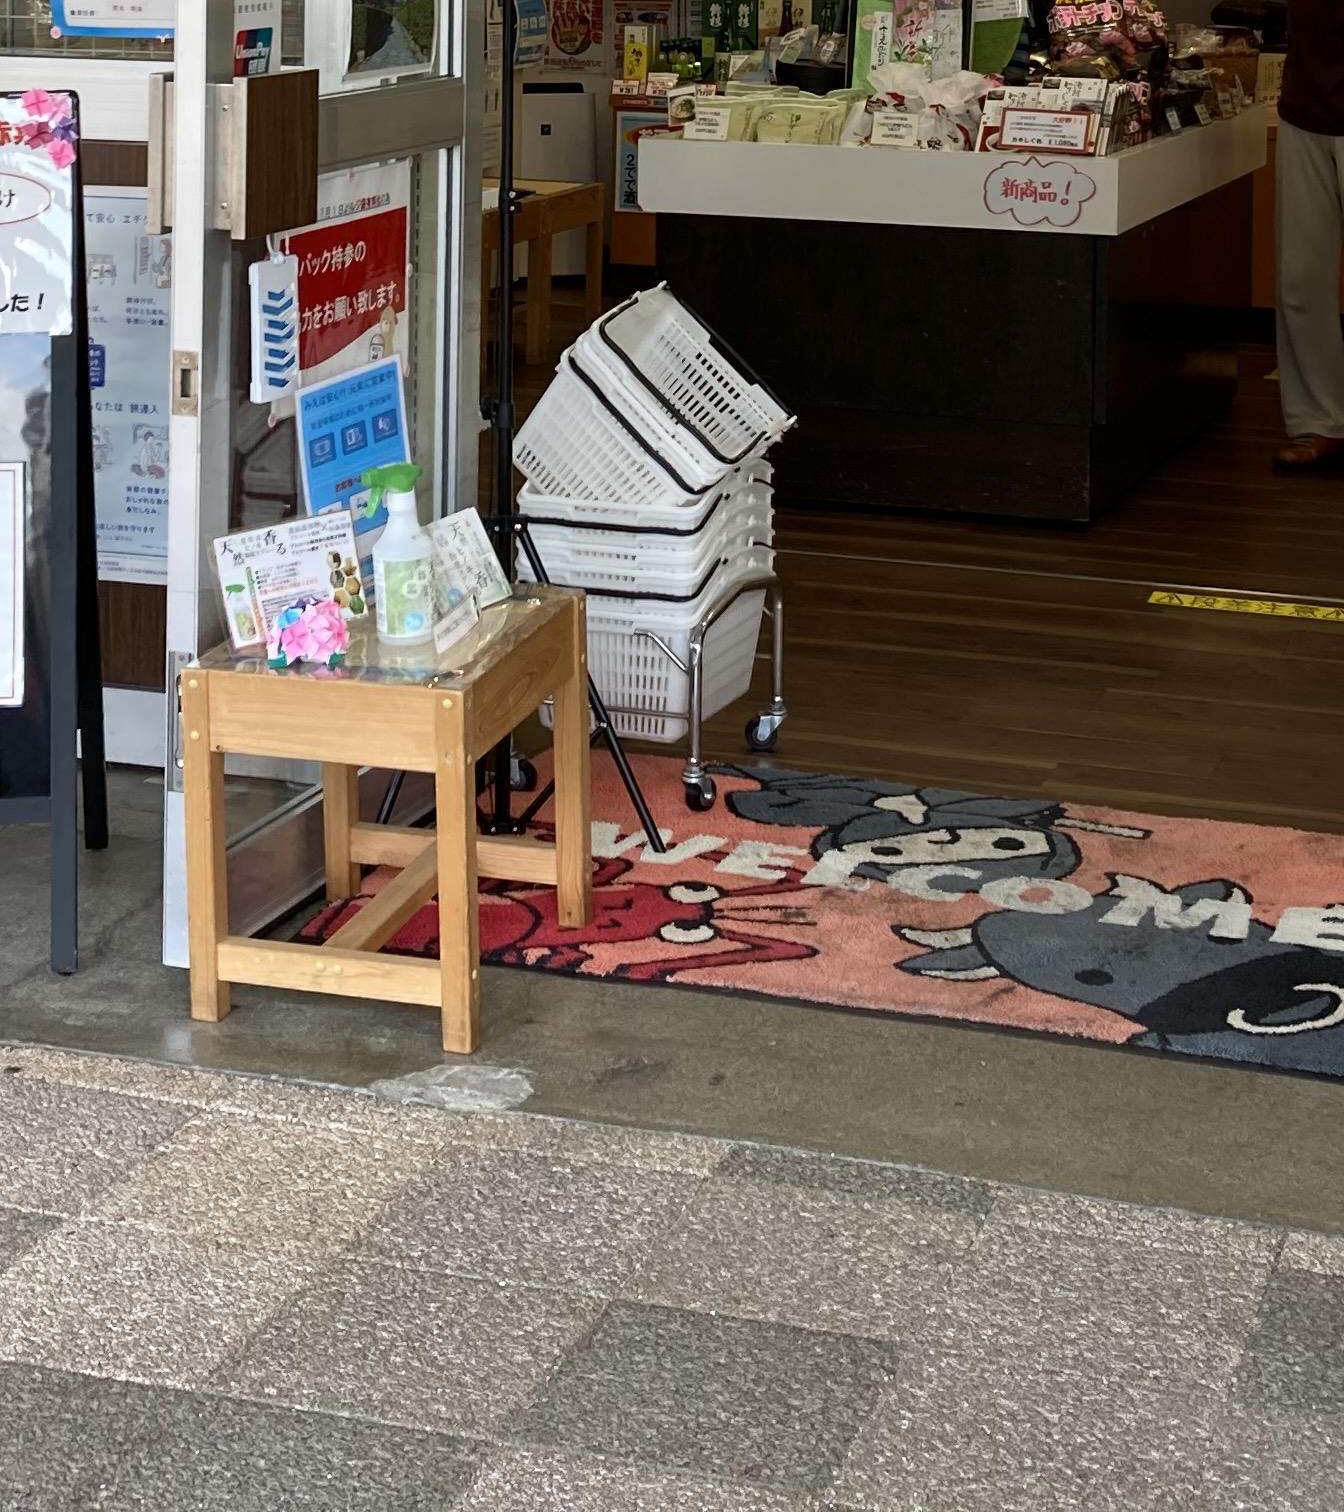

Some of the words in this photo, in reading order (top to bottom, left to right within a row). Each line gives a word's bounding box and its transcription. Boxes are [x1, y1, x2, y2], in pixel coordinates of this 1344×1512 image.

[1000, 177, 1072, 206] 新商品！
[298, 280, 400, 334] 力をお願い致します。
